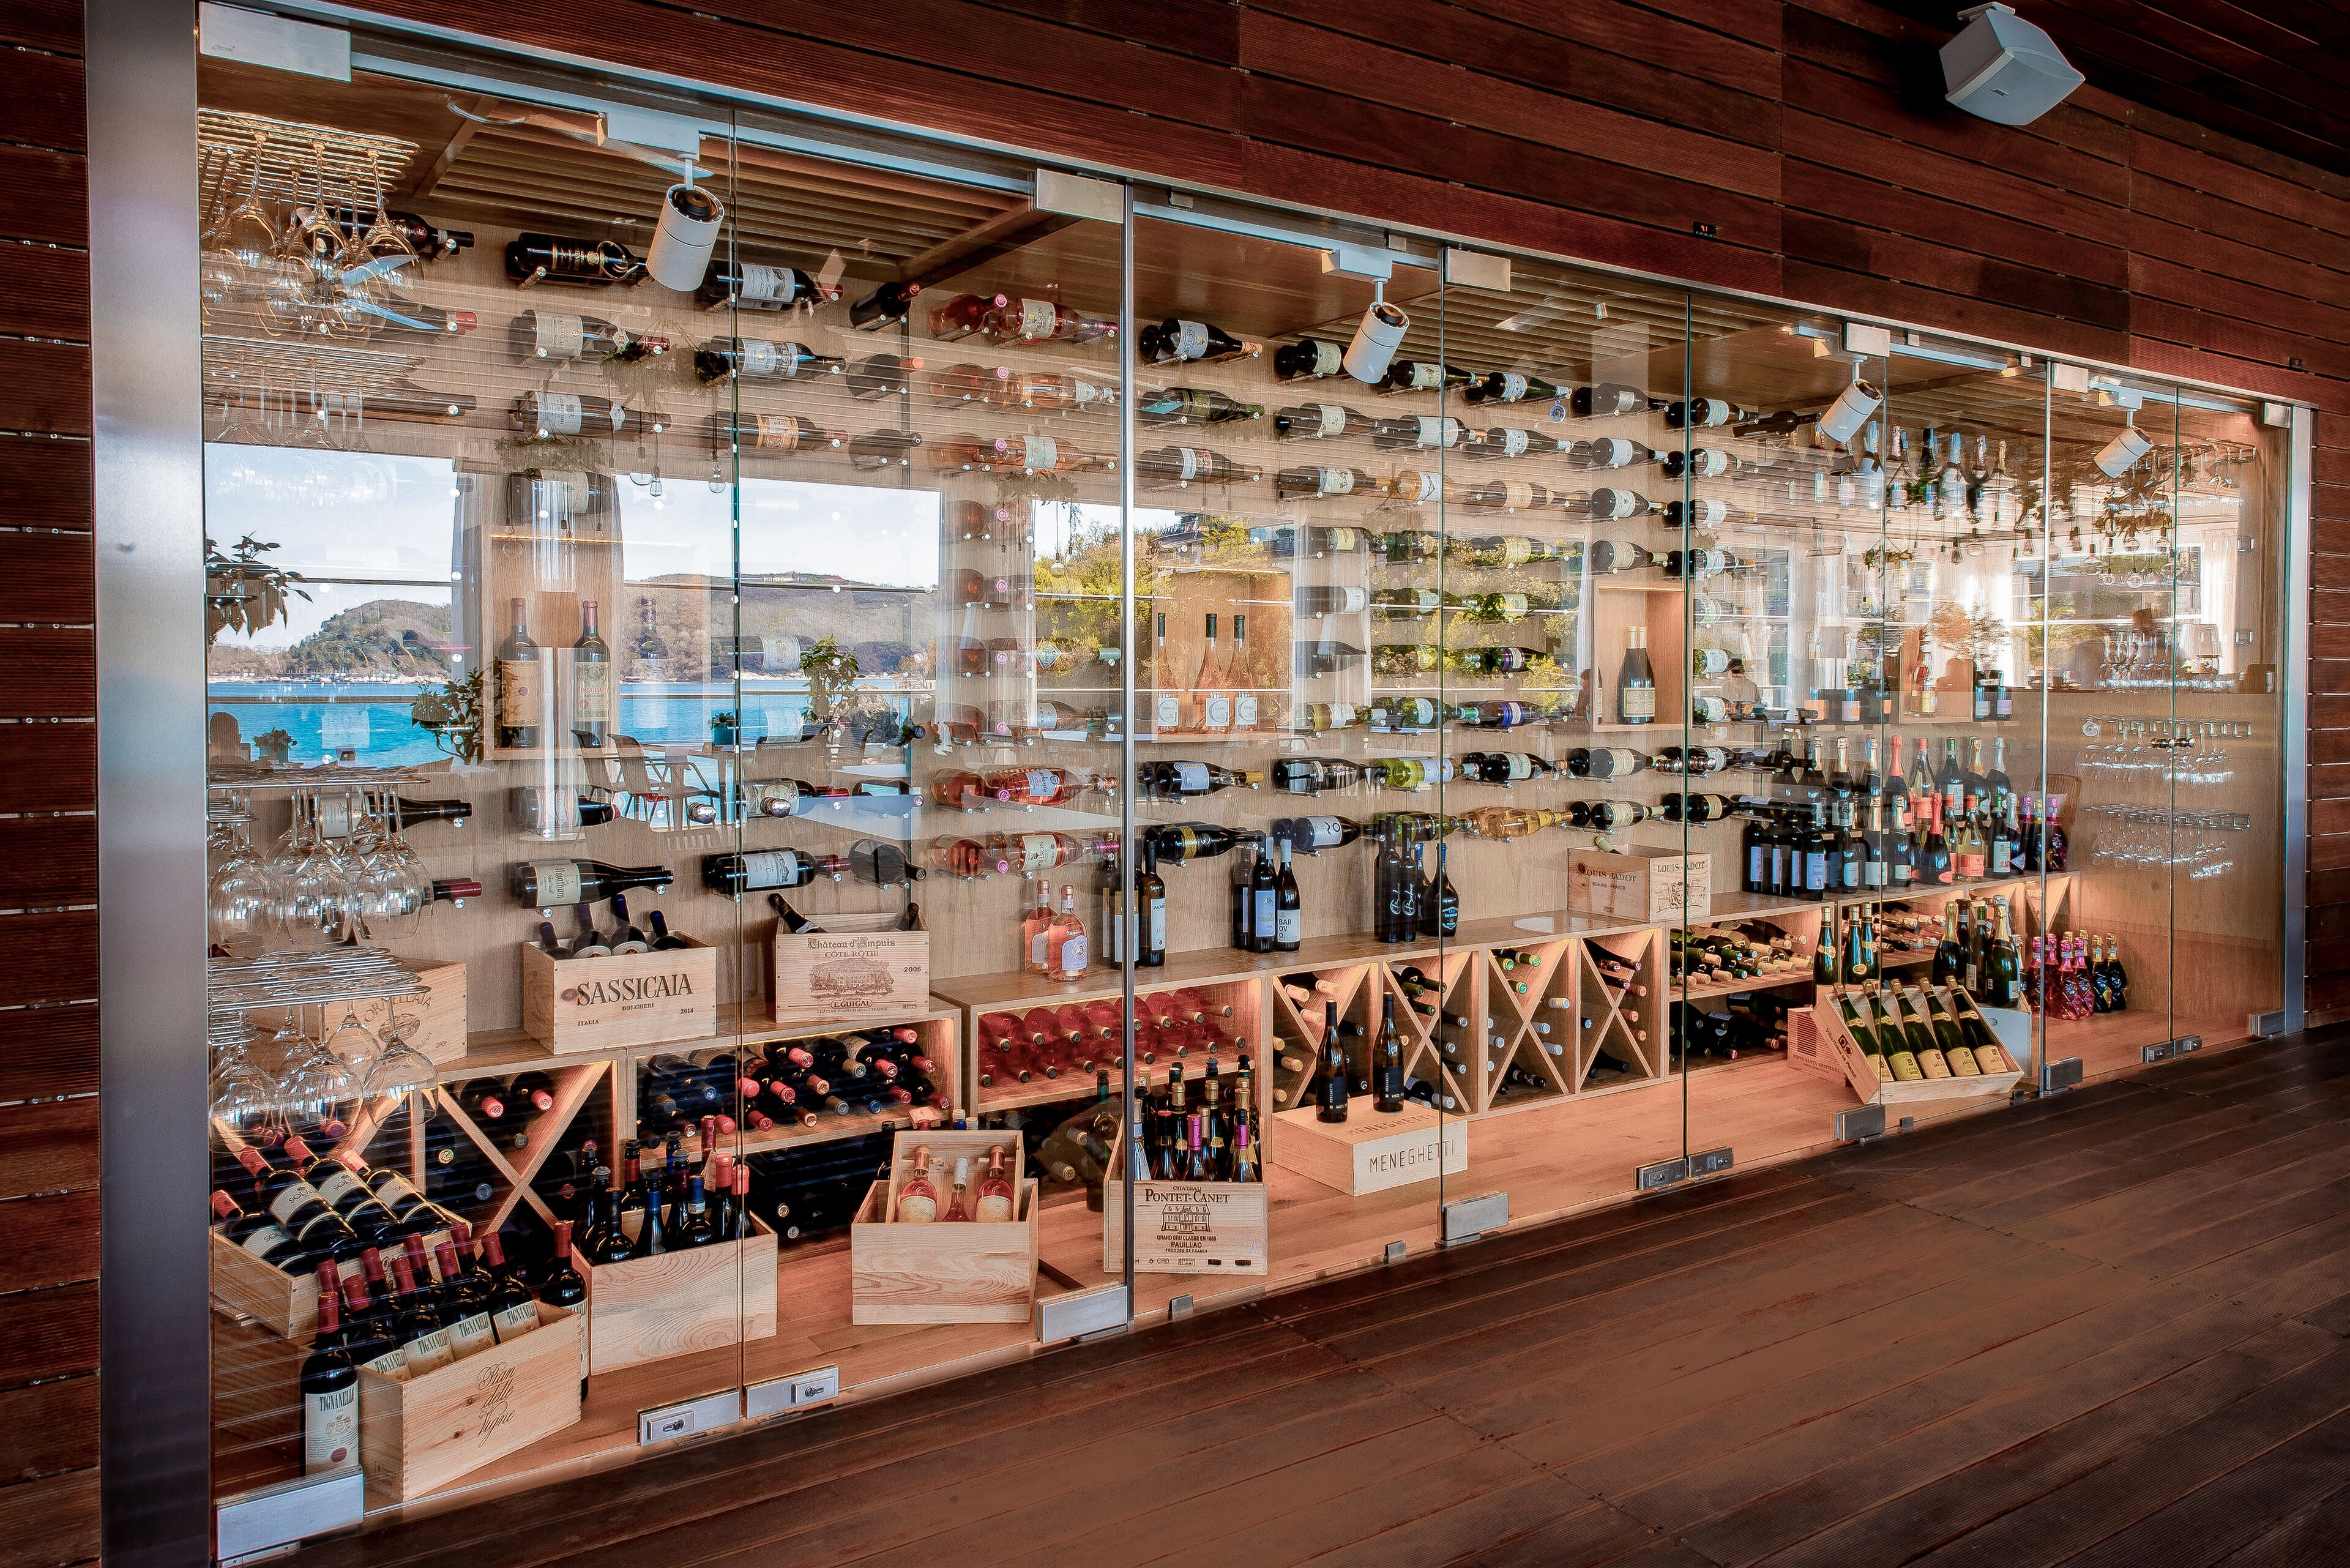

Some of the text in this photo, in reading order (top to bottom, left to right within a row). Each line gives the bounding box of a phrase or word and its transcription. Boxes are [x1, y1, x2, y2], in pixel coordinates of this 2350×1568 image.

[1034, 306, 1043, 333] NOSTRA
[1583, 868, 1637, 883] LOUIS JADOT
[1657, 864, 1679, 873] LOUIS
[807, 938, 847, 950] Château
[825, 950, 879, 958] CÔTE-RÔTIE
[576, 973, 694, 1007] SASSICAIA
[622, 1002, 655, 1012] BOLGHERI
[1348, 1114, 1436, 1136] MENEGHETTI
[1369, 1139, 1455, 1173] MENEGHETTI
[1144, 1188, 1230, 1203] PONTET-CANET
[319, 1387, 356, 1412] TIGNANELLO
[481, 1378, 515, 1409] delle
